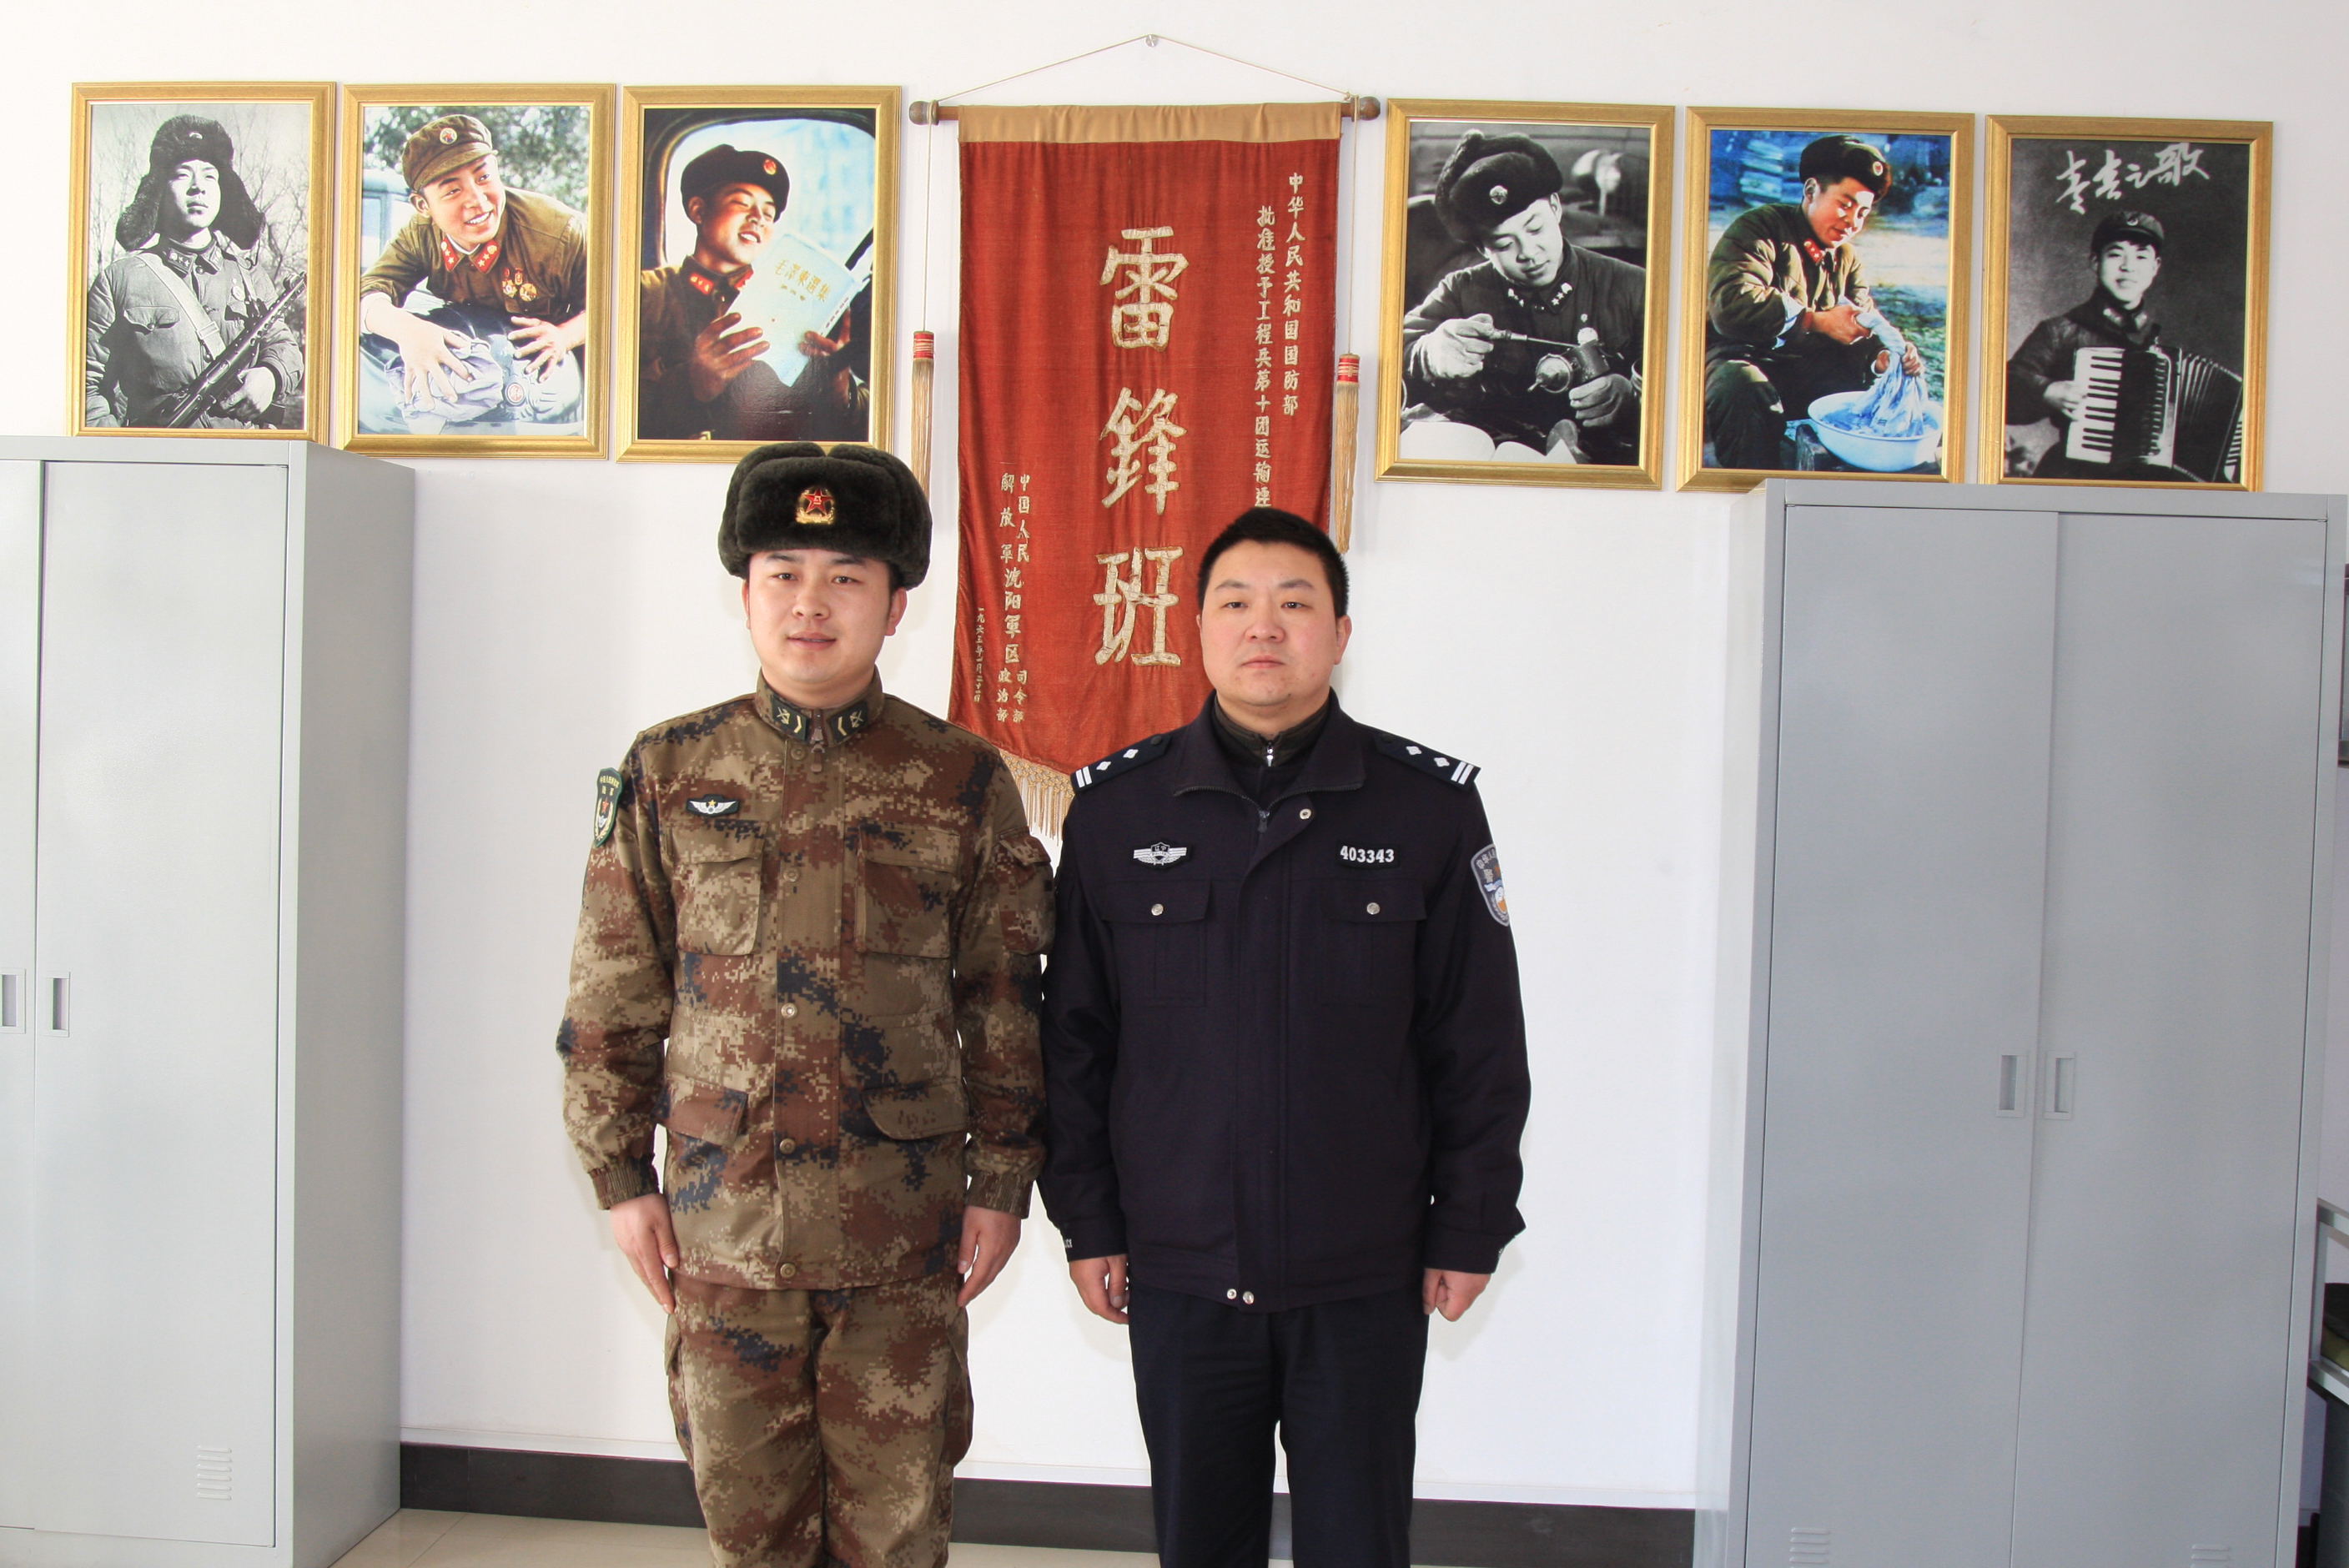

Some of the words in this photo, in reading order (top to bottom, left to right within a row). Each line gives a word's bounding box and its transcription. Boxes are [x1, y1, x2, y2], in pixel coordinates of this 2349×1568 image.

[1282, 172, 1305, 415] 中华人民共和国国防部
[1340, 845, 1395, 864] 403343
